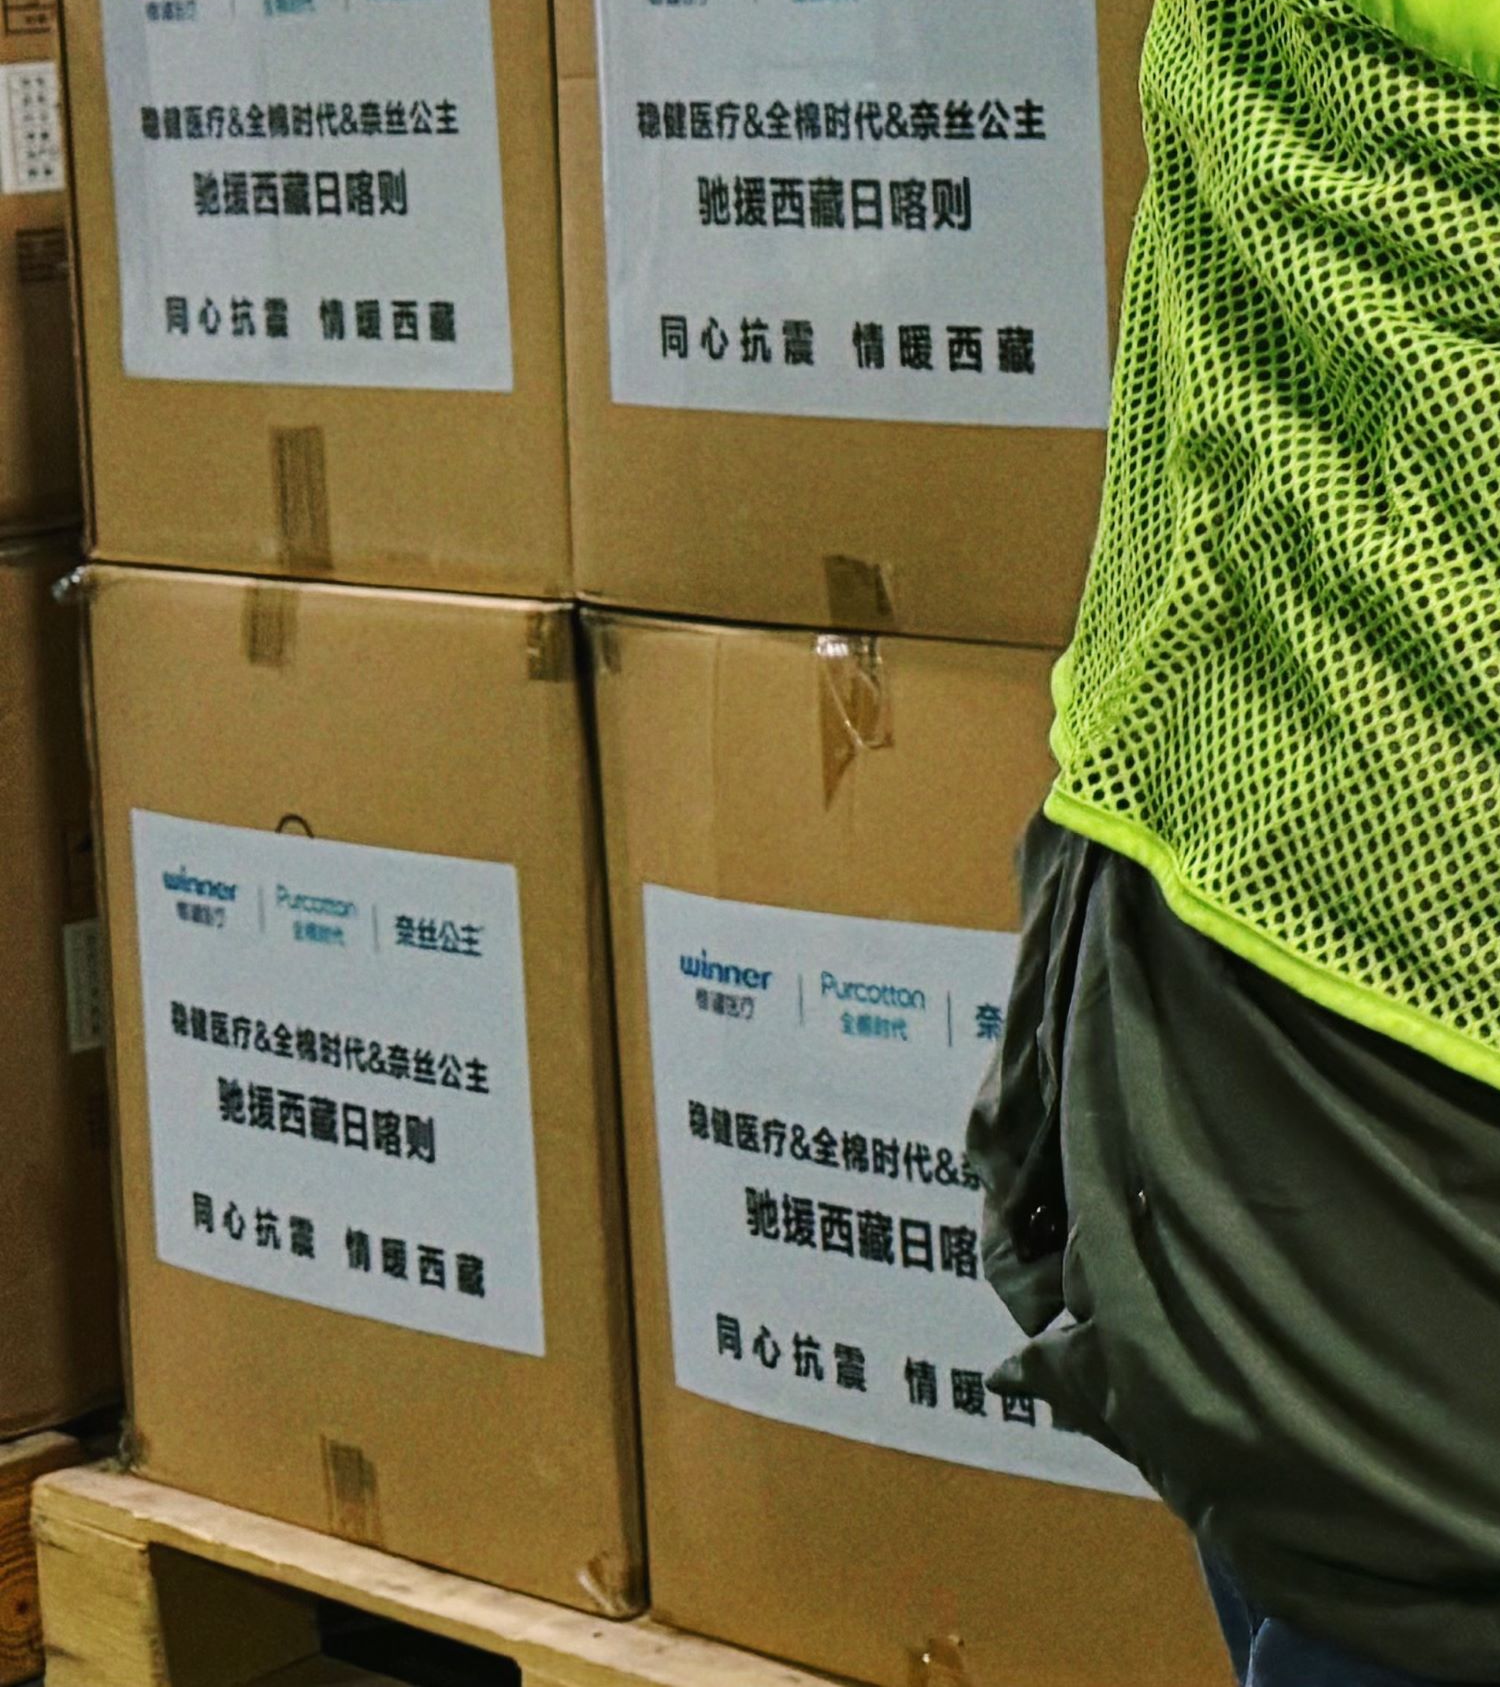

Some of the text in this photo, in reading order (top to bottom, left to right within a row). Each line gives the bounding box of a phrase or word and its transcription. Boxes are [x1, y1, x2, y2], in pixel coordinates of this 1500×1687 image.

[636, 98, 1047, 142] 稳健医疗&全棉时代&奈丝公主
[193, 168, 408, 217] 驰援西藏日喀则
[697, 175, 972, 232] 驰援西藏日喀则
[165, 295, 457, 343] 同心抗震 情暖西藏
[660, 314, 1036, 375] 同心抗震 情暖西藏
[679, 949, 773, 991] winner
[820, 970, 926, 1011] Purcotton
[217, 1076, 437, 1165] 驰援西藏日喀则
[192, 1191, 486, 1299] 同心抗震 情暖西藏
[715, 1312, 868, 1393] 同心抗震
